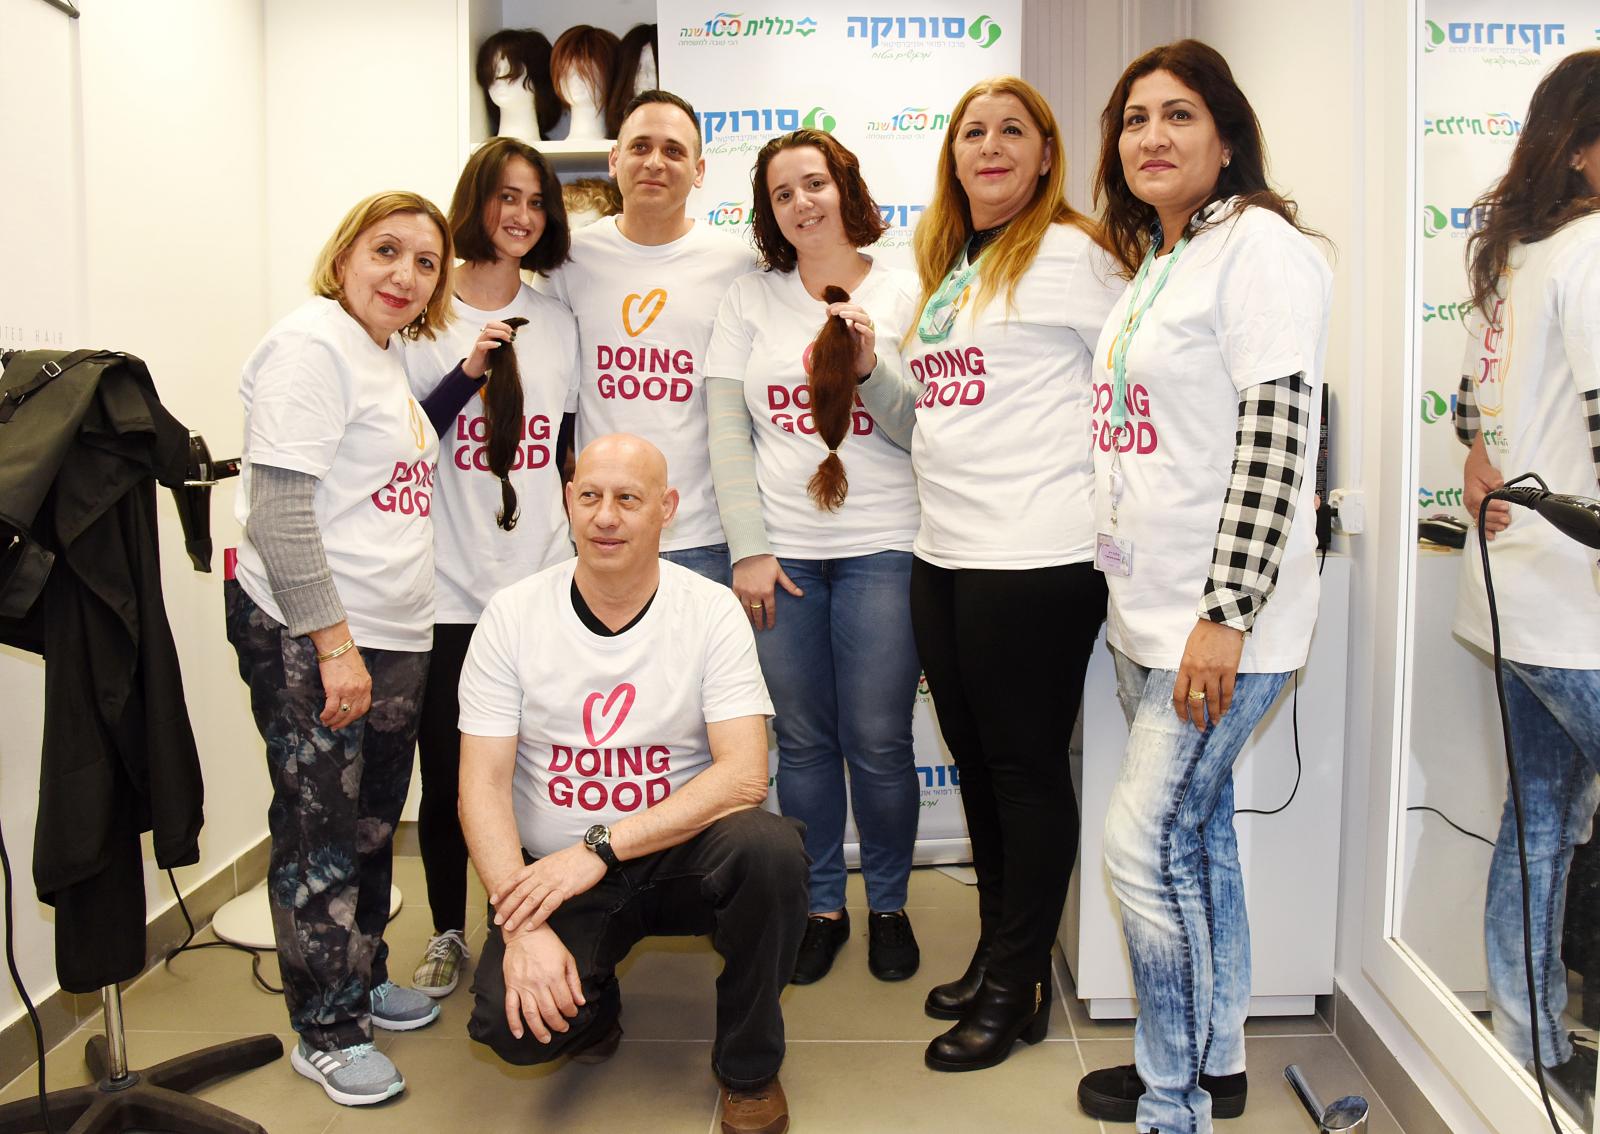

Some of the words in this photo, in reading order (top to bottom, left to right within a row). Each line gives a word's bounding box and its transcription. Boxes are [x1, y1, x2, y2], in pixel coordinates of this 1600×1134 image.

[680, 27, 703, 37] שנה
[704, 19, 742, 37] 100
[743, 16, 794, 36] כללית
[847, 16, 965, 49] סורוקה
[695, 109, 799, 144] סורוק
[867, 121, 890, 131] שנה
[597, 345, 694, 375] DOING
[910, 346, 987, 384] DOING
[597, 374, 694, 402] GOOD
[771, 410, 874, 436] GOD
[371, 483, 433, 517] GOO
[548, 744, 671, 778] DOING
[547, 776, 671, 812] GOOD
